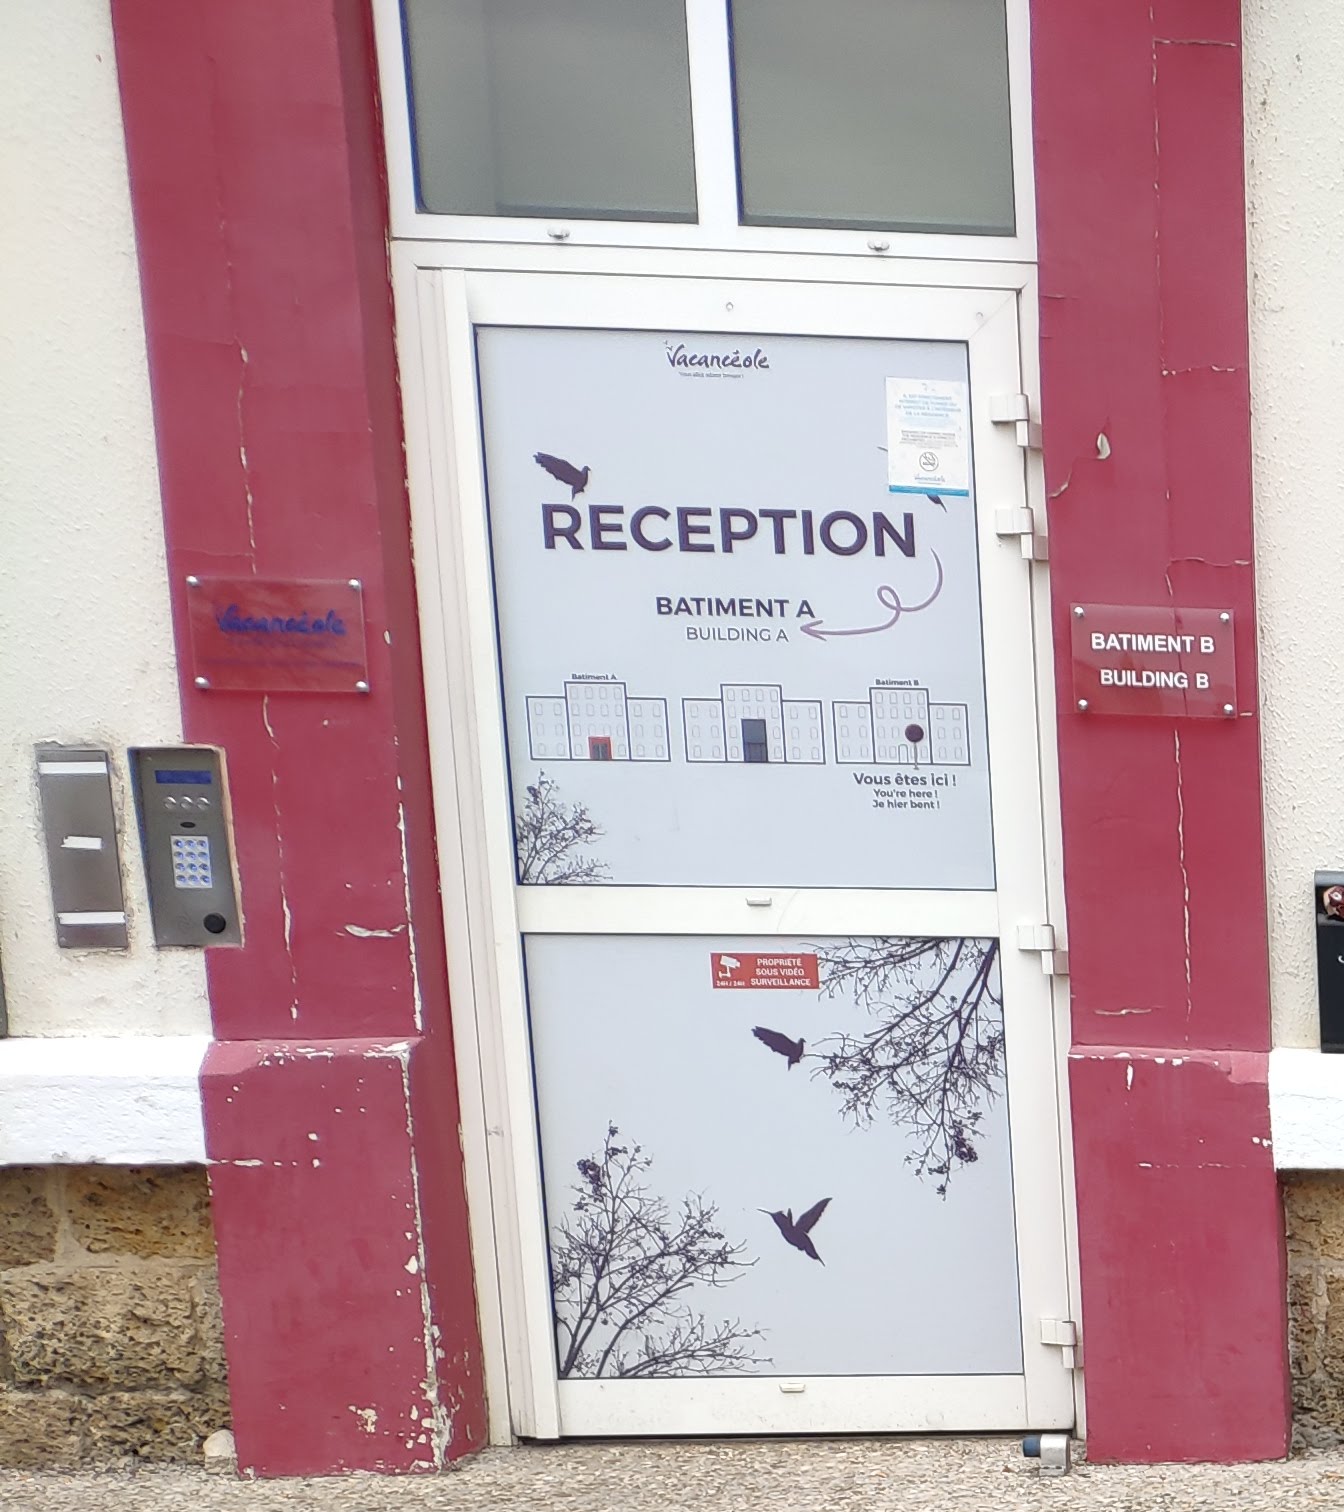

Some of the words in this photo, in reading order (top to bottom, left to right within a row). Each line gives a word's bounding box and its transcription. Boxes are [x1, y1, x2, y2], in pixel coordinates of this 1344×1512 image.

[666, 343, 770, 369] Vacancéole
[541, 502, 917, 558] RECEPTION
[656, 596, 789, 618] BATIMENT
[796, 599, 816, 619] A
[686, 626, 771, 642] BUILDING
[775, 629, 789, 643] A
[1091, 632, 1194, 653] BATIMENT
[1200, 636, 1215, 653] B
[1100, 669, 1188, 689] BUILDING
[1196, 673, 1209, 689] B
[853, 772, 891, 786] Vous
[894, 773, 927, 786] êtes
[930, 773, 948, 787] ici
[909, 789, 933, 799] here
[755, 968, 778, 976] SOUS
[750, 978, 811, 986] SURVEILLANCE
